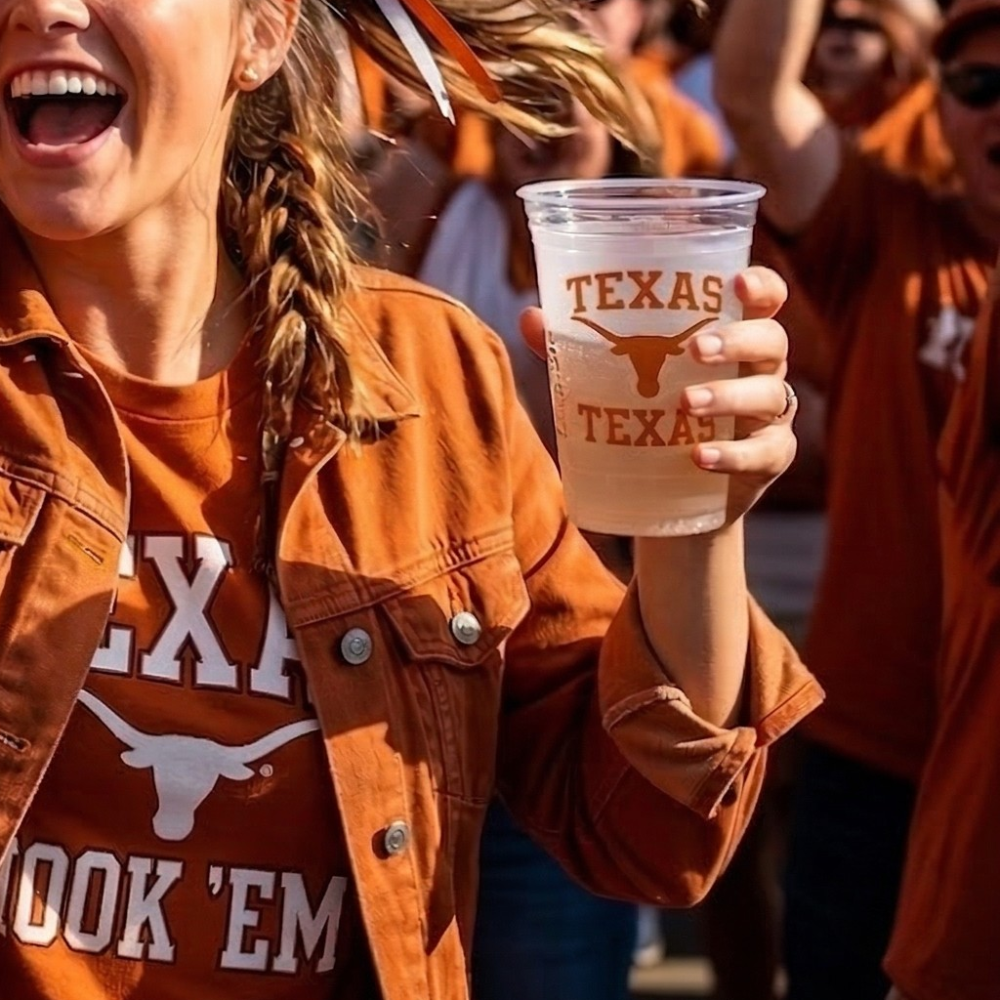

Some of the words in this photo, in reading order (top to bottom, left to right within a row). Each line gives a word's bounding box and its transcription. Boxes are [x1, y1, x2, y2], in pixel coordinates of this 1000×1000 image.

[566, 270, 723, 314] TEXAS
[577, 403, 716, 447] TEXAS
[208, 864, 348, 974] 'EM
